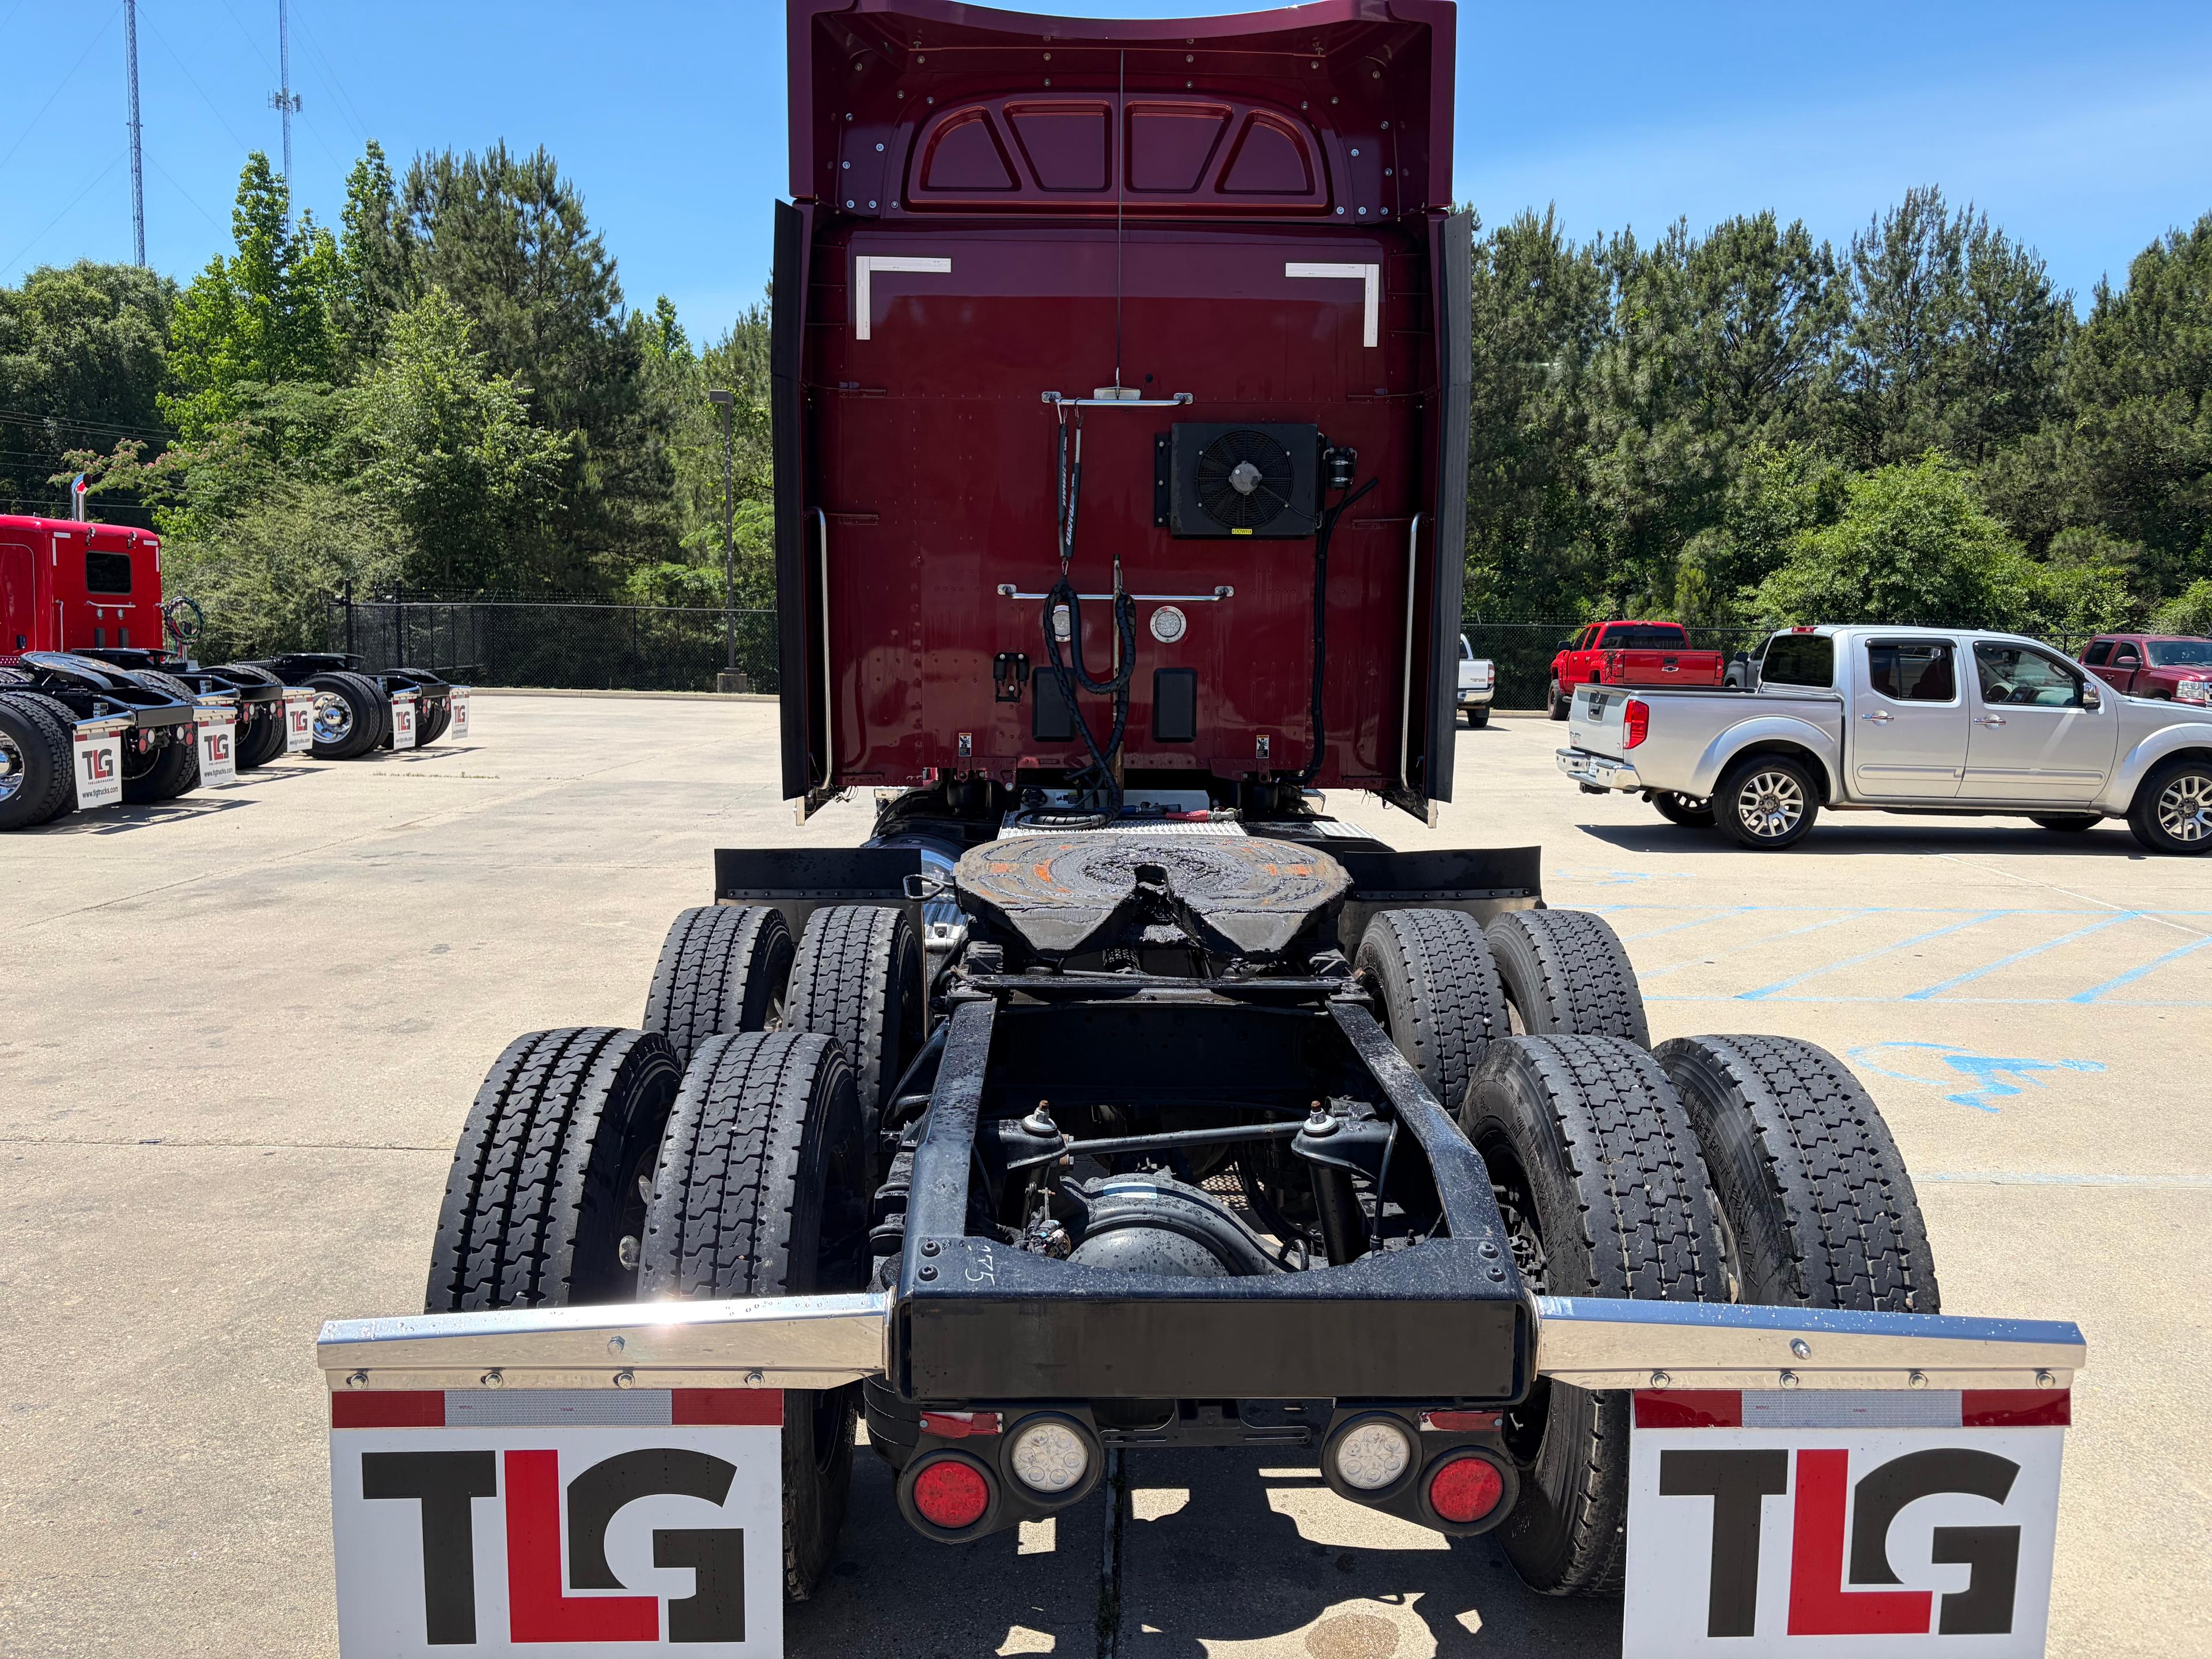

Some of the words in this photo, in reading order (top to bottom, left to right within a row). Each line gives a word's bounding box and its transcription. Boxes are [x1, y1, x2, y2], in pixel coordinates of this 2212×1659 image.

[290, 710, 308, 733] TLG
[396, 711, 411, 731] TLG
[204, 734, 229, 761] TLG
[82, 748, 113, 780] TLG
[82, 786, 119, 798] www.tlgtrucks.com
[362, 1448, 745, 1645] TLG
[1659, 1448, 2022, 1638] TLG
